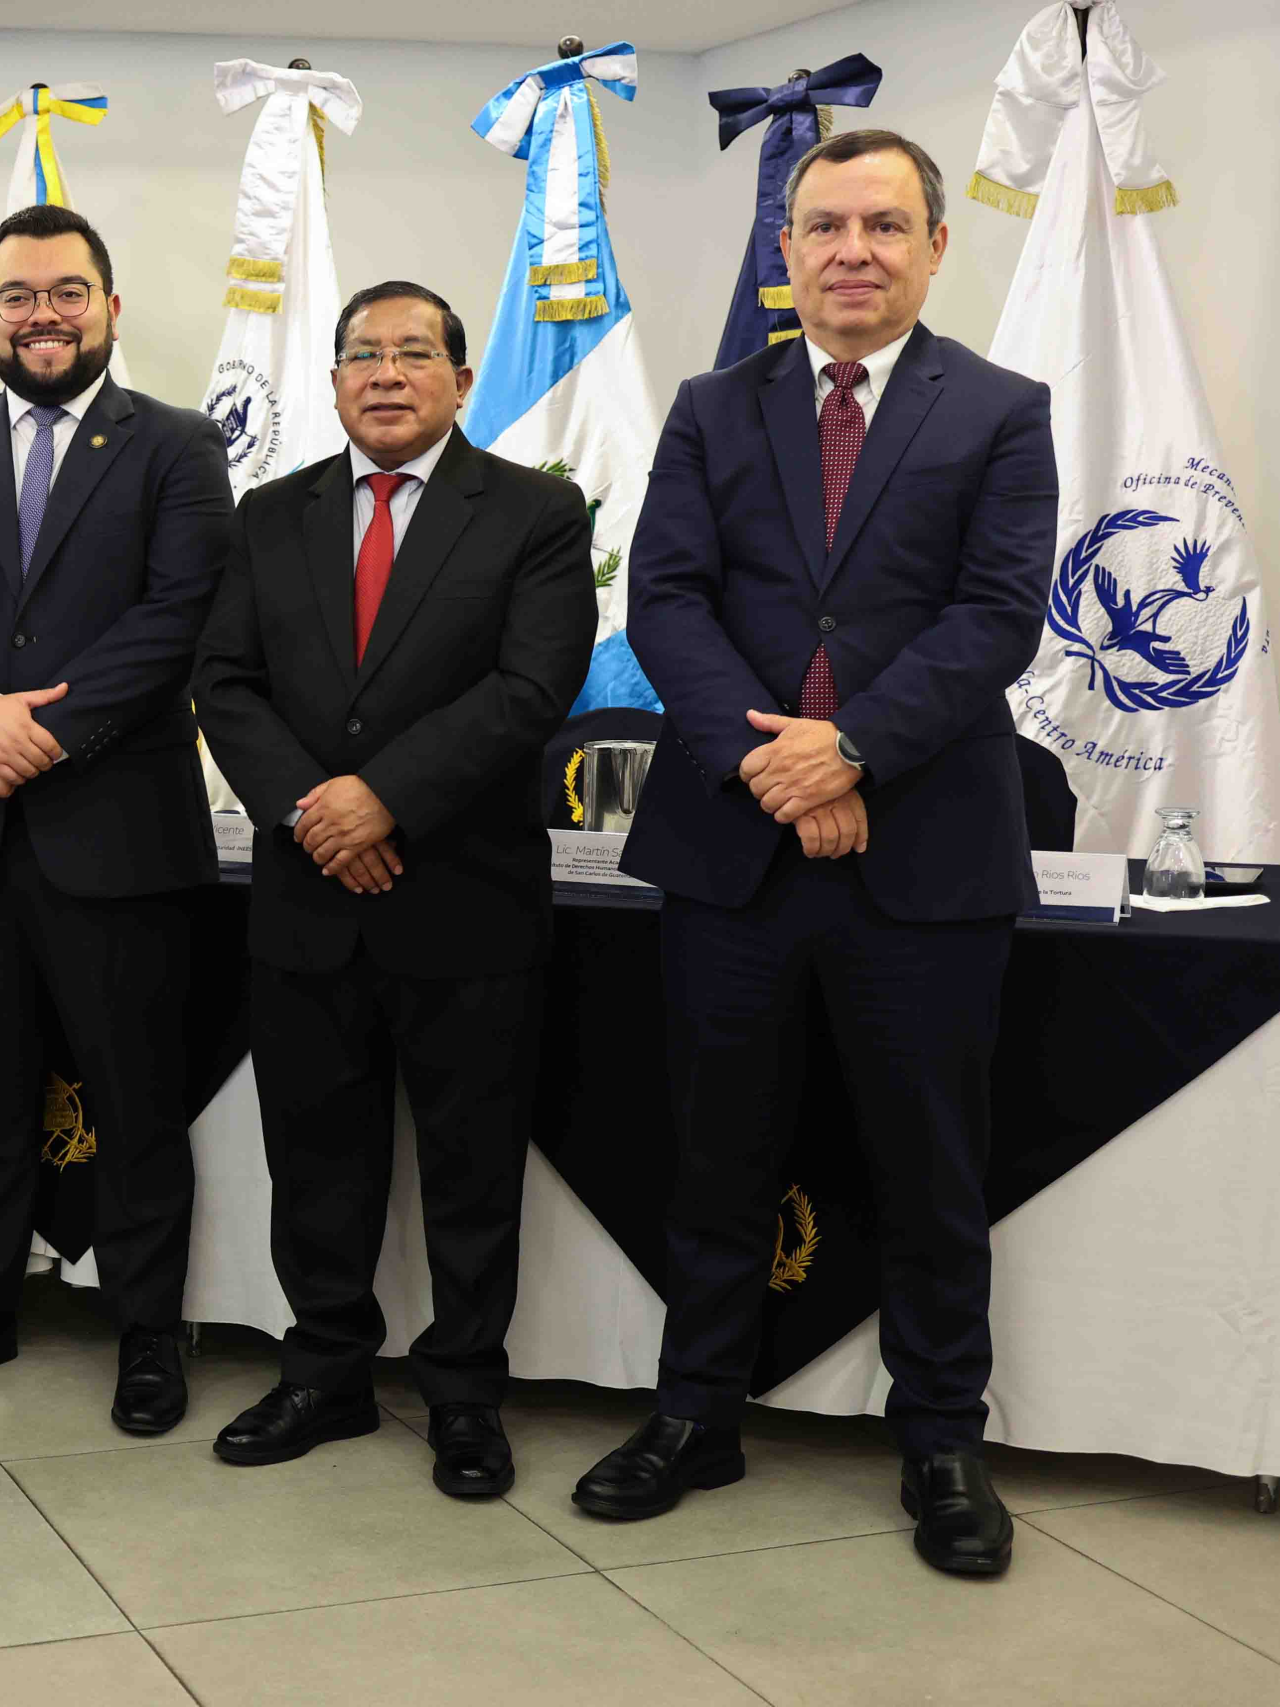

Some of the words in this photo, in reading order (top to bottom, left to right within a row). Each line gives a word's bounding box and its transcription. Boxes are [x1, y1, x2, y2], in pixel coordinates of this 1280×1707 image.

[255, 373, 269, 389] DE
[266, 391, 277, 407] LA
[252, 412, 282, 479] REPÚBLICA
[1185, 457, 1237, 497] Mecan
[1124, 473, 1180, 492] Oficina
[1184, 475, 1197, 489] de
[1201, 483, 1247, 534] Preven
[1076, 741, 1164, 771] América
